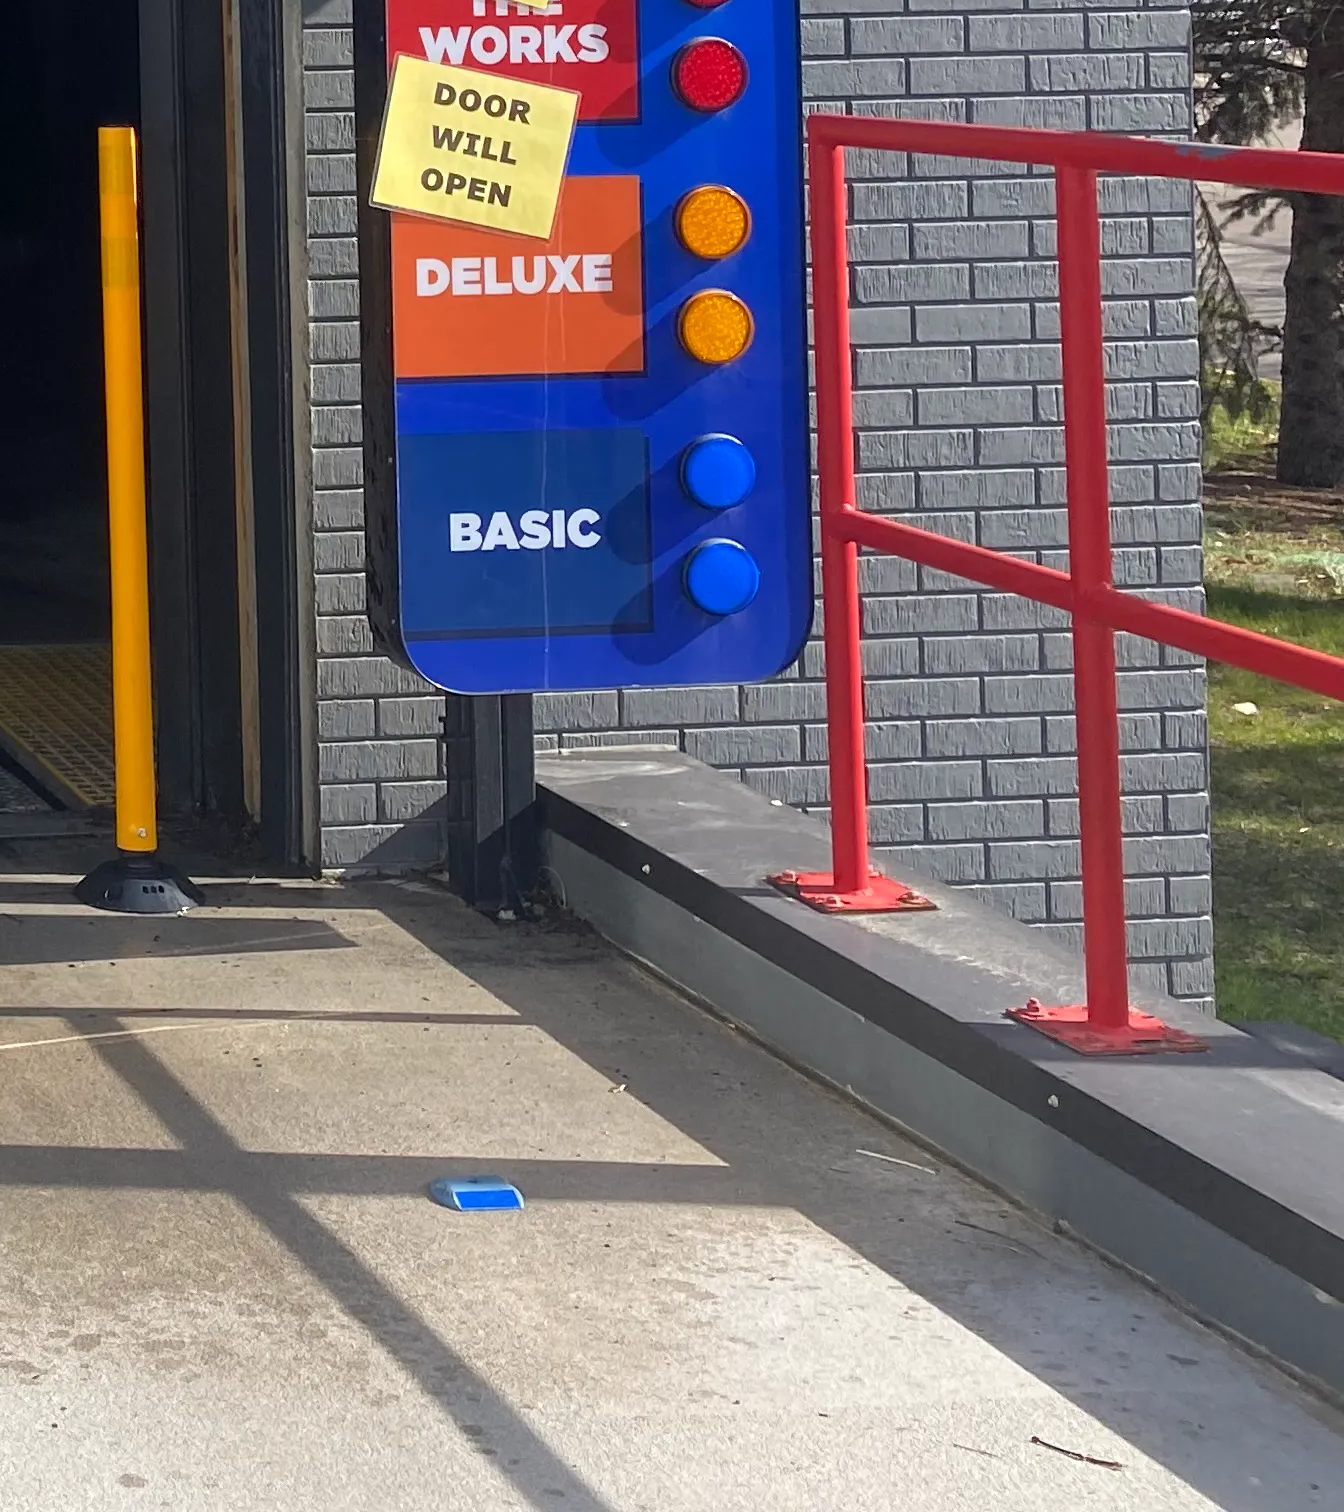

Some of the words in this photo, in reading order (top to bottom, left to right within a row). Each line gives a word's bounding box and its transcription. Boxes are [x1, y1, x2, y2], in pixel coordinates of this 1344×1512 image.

[419, 24, 609, 65] WORKS
[433, 82, 531, 125] DOOR
[432, 126, 516, 165] WILL
[421, 168, 511, 207] OPEN
[416, 254, 612, 297] DELUXE
[450, 508, 601, 552] BASIC
